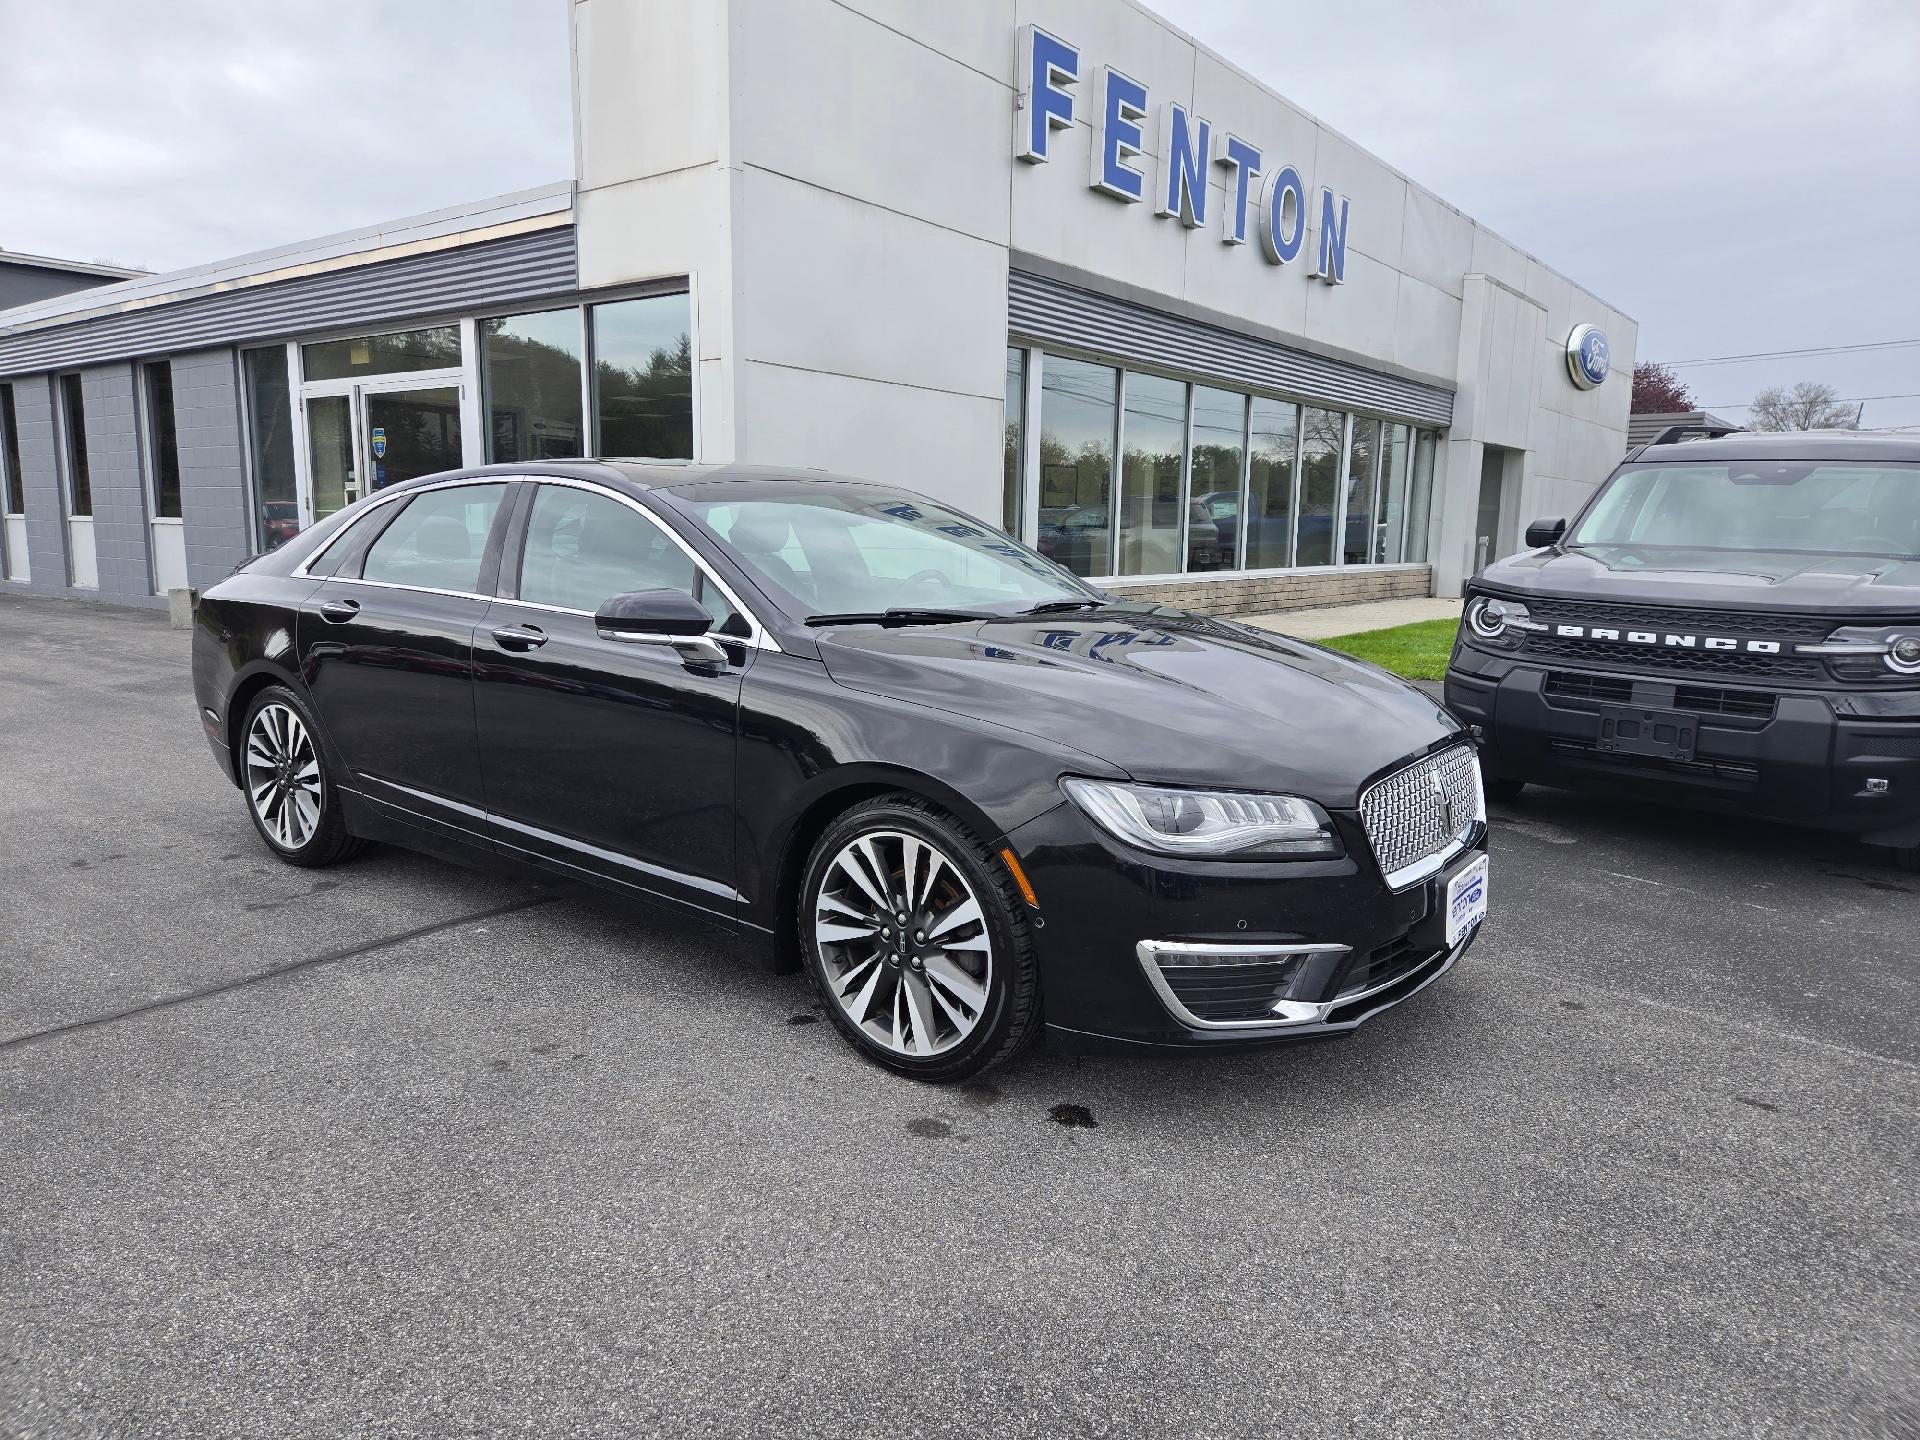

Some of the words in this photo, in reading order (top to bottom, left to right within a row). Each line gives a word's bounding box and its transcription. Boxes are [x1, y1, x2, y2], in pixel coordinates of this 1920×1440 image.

[1019, 24, 1352, 286] FENTON
[1587, 337, 1609, 374] Ford
[1557, 624, 1781, 654] BRONCO
